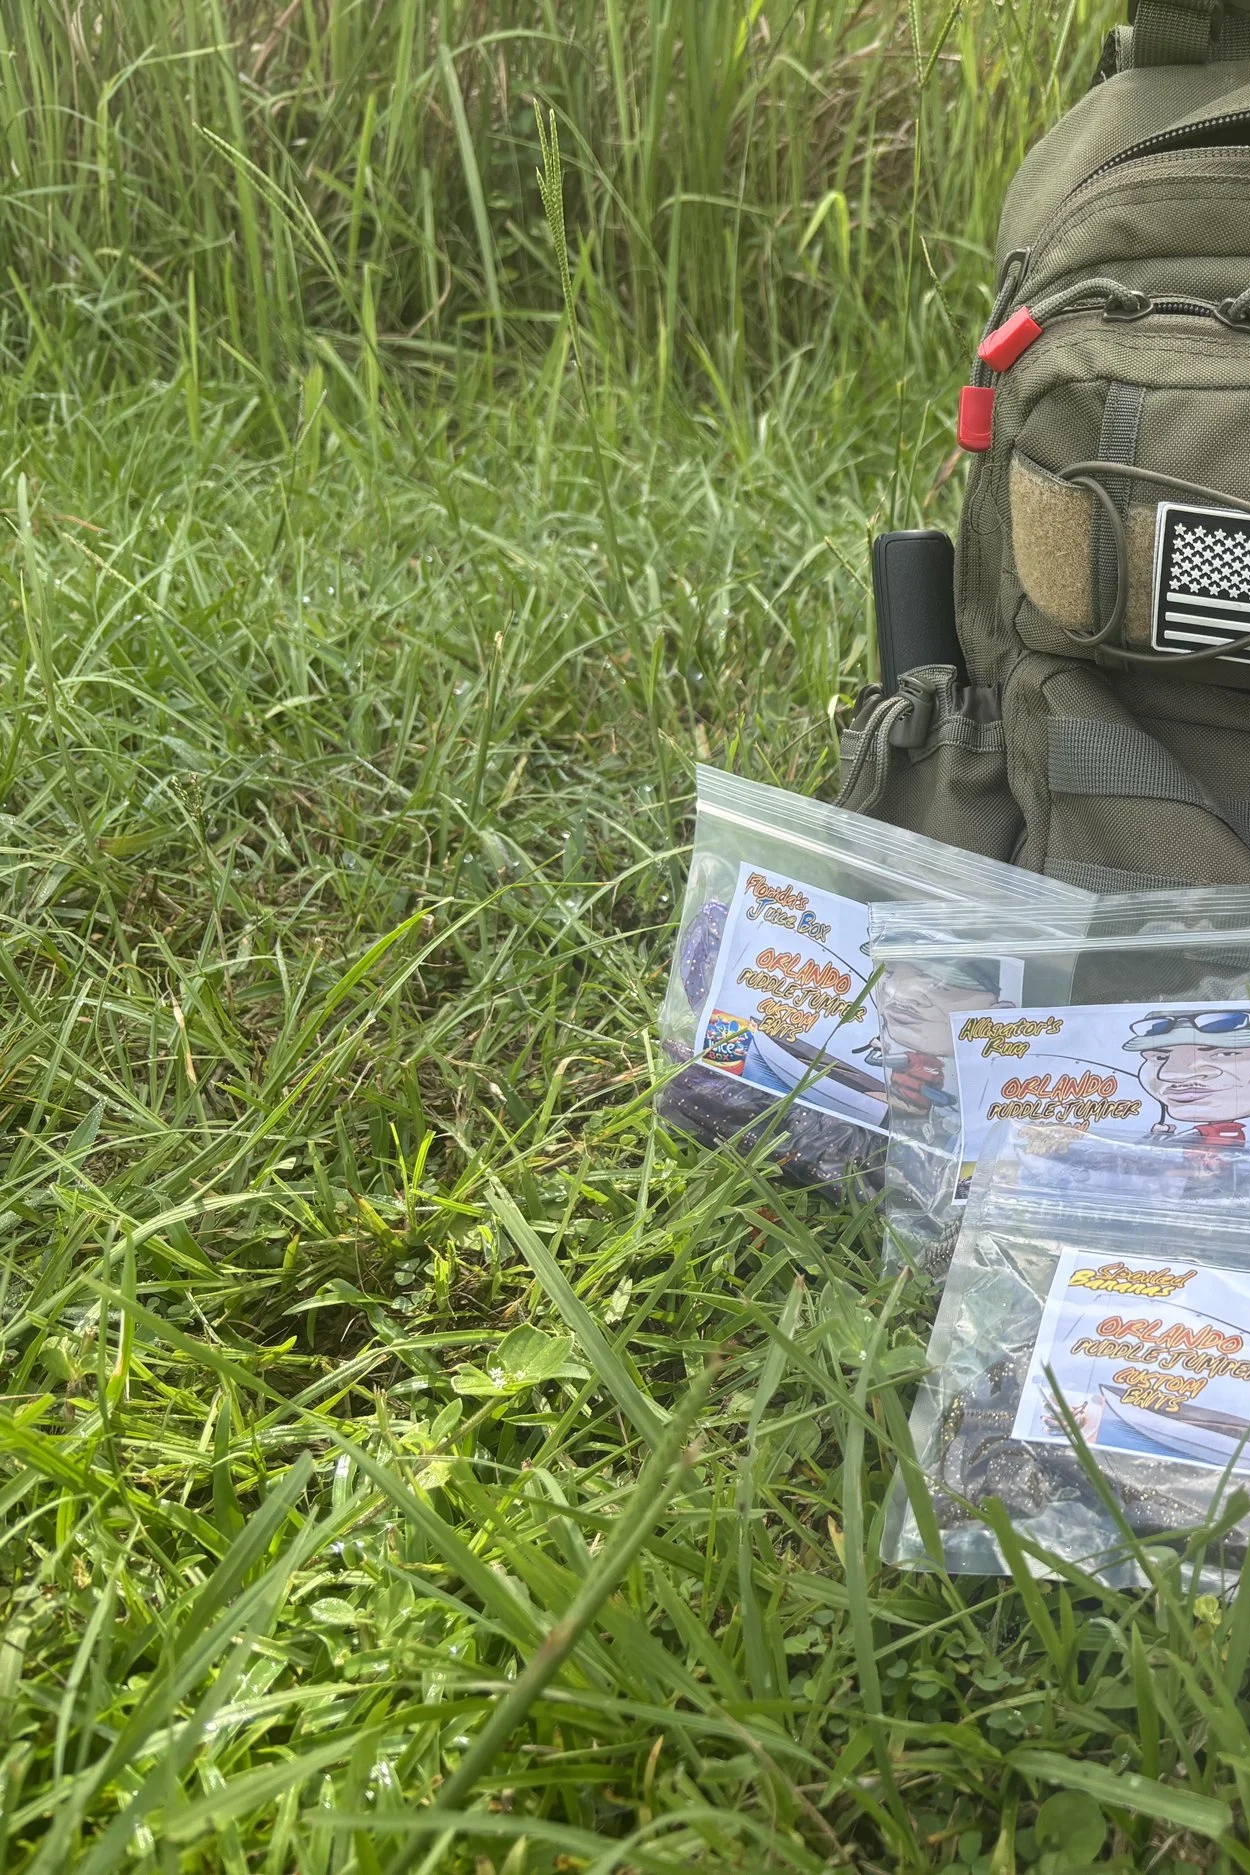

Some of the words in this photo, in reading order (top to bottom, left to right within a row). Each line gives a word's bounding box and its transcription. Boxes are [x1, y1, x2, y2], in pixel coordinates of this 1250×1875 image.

[744, 872, 809, 911] Florida's
[797, 910, 831, 943] Box
[737, 967, 802, 999] PUDDLE
[756, 947, 851, 996] ORLANDO
[757, 998, 820, 1033] CUSTOM
[758, 1015, 804, 1043] BAITS
[959, 1016, 1064, 1041] Alligator's
[1001, 1070, 1117, 1101] ORLANDO
[987, 1101, 1056, 1120] PUDDLE
[1056, 1099, 1142, 1122] JUMPER
[1068, 1269, 1176, 1297] Bananas
[1098, 1262, 1198, 1288] Spoiled
[1096, 1316, 1243, 1354] ORLANDO
[1071, 1338, 1160, 1364] PUDDLE
[1113, 1367, 1208, 1399] CUSTOM
[1120, 1387, 1188, 1413] BAITS
